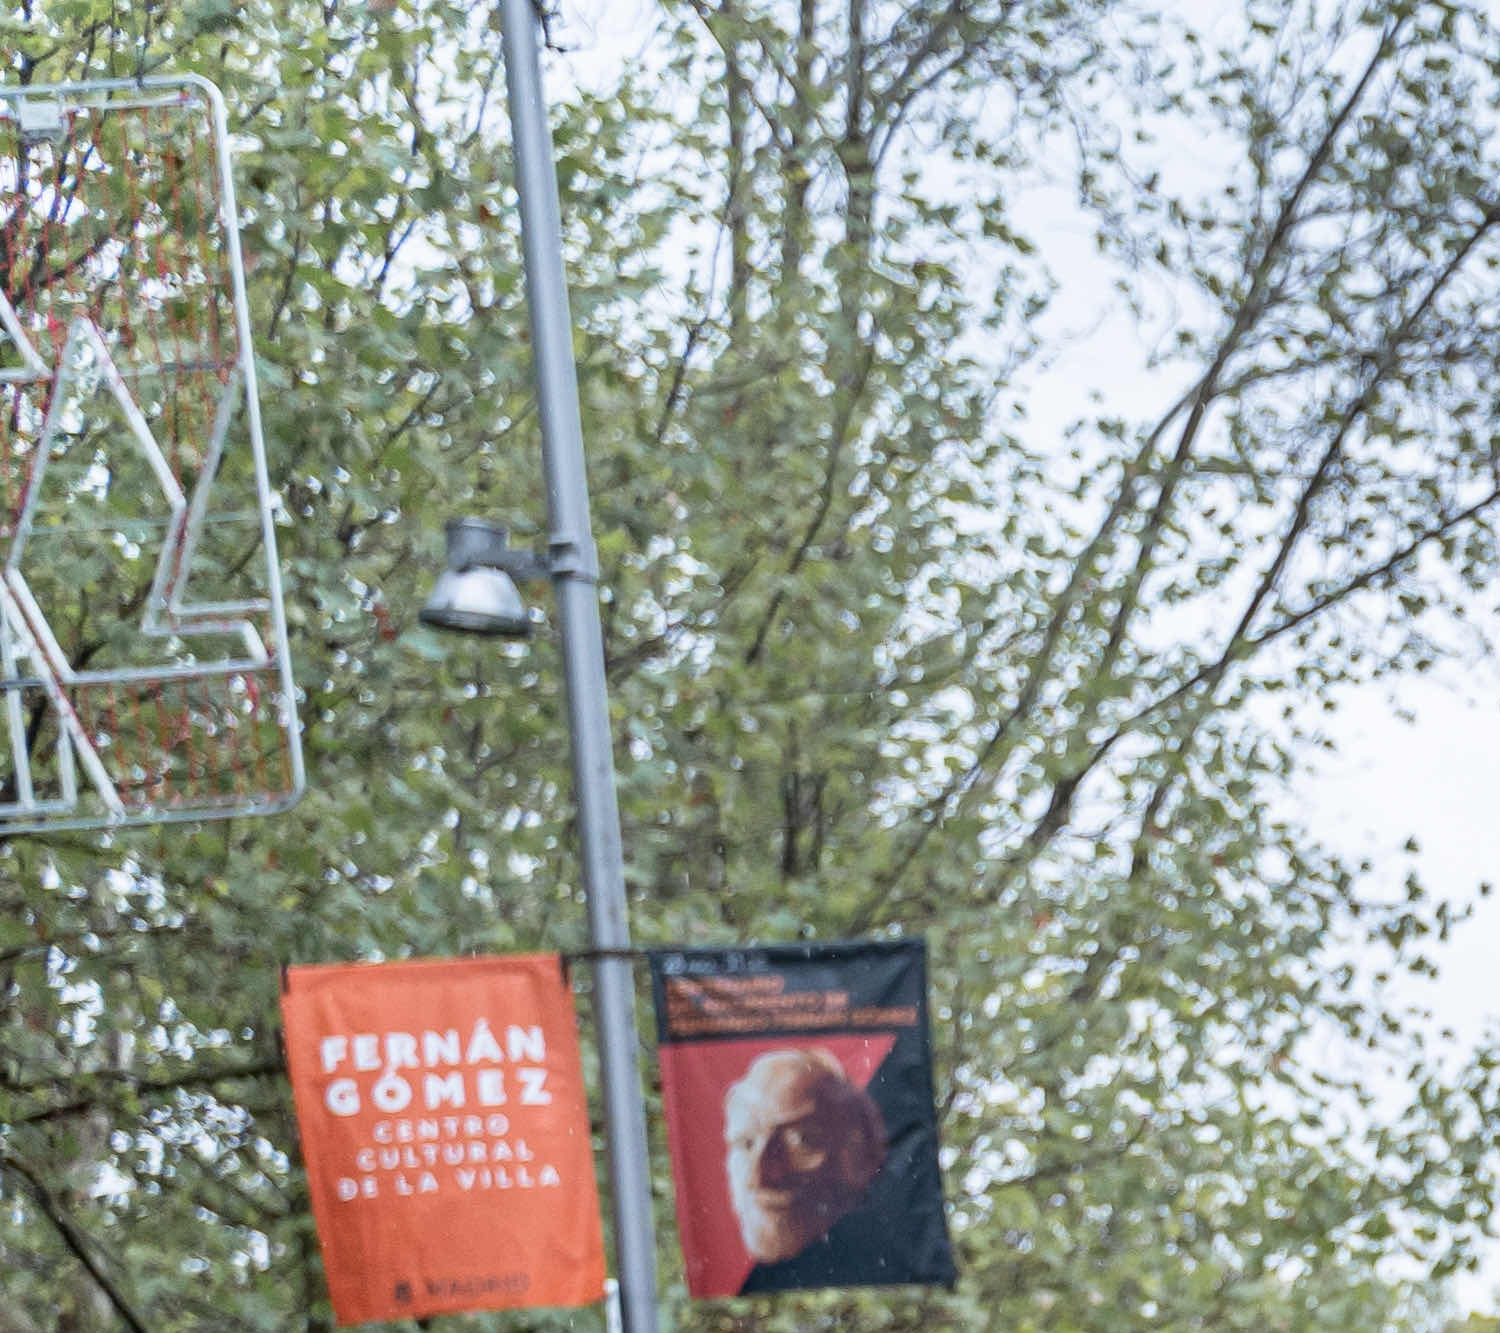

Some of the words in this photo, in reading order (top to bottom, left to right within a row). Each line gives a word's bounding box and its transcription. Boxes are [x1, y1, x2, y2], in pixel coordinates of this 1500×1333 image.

[320, 1017, 546, 1074] FERNÁN
[324, 1063, 552, 1117] GÓMEZ
[373, 1110, 510, 1144] CENTRO
[356, 1139, 535, 1172] CULTURAL
[337, 1176, 379, 1201] DE
[395, 1170, 439, 1196] LA
[456, 1164, 560, 1191] VILLA
